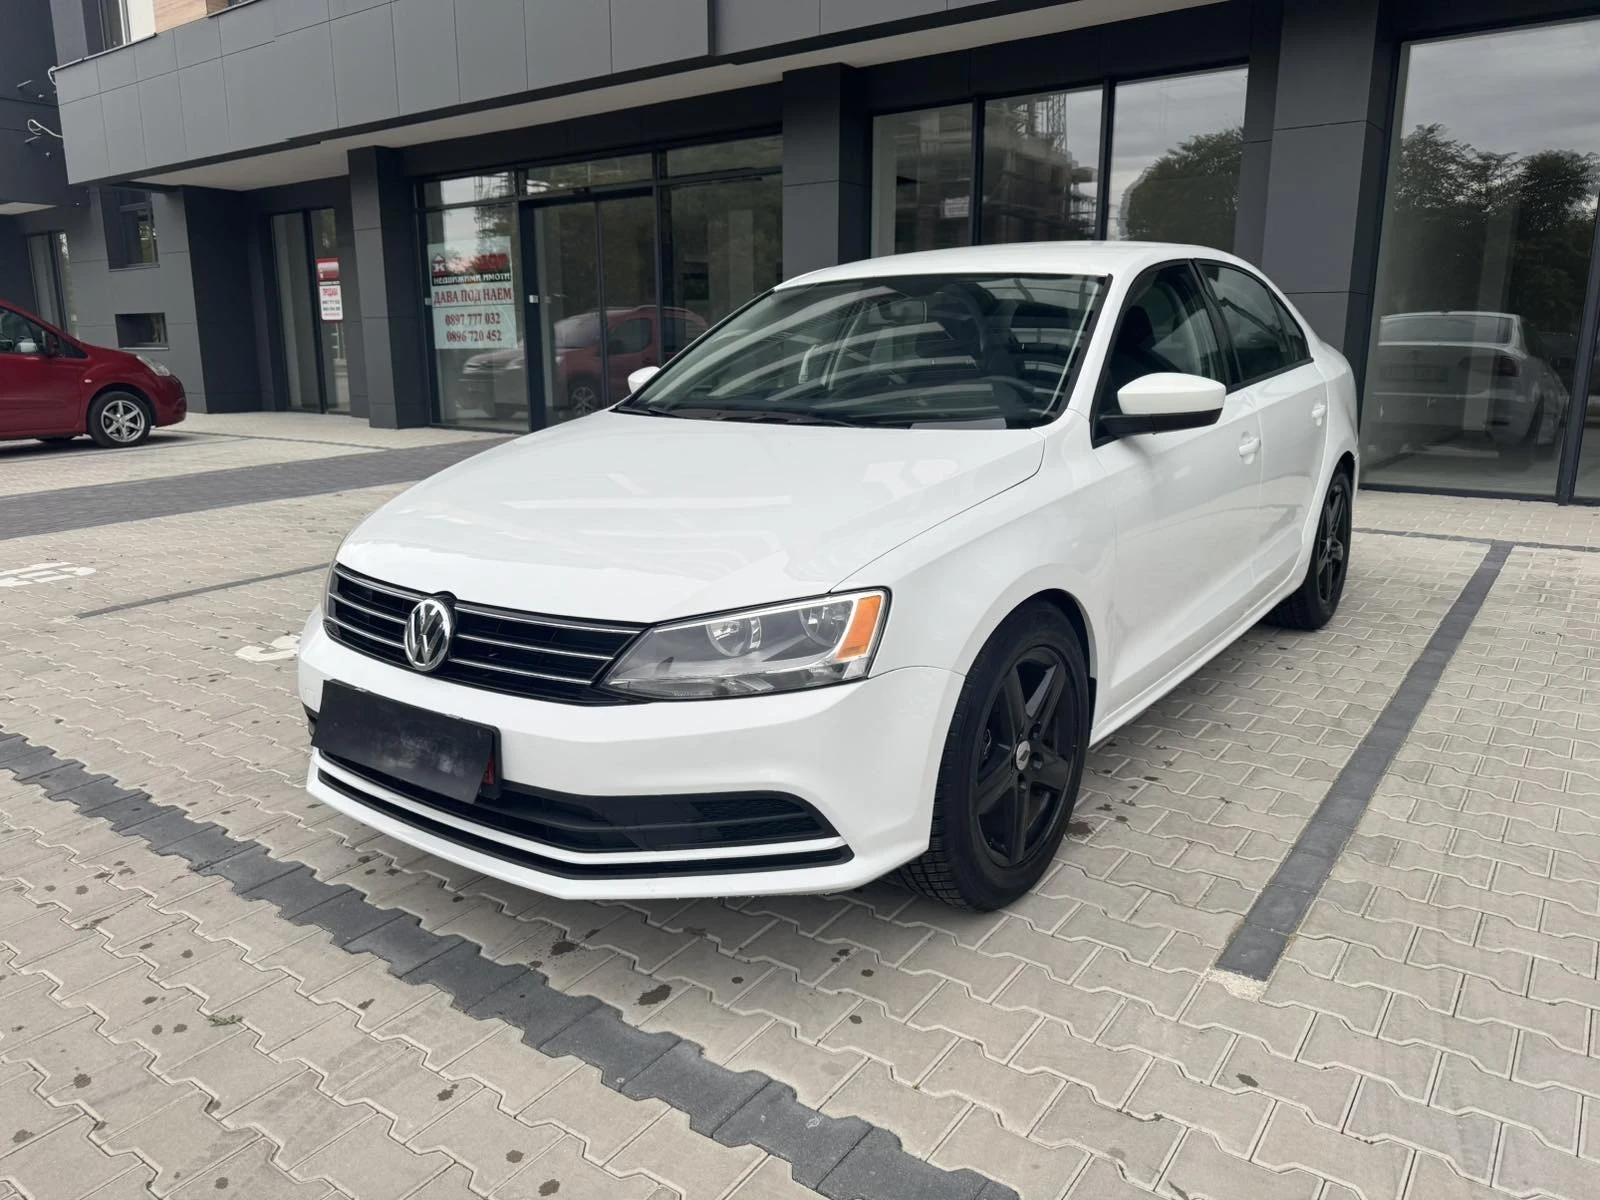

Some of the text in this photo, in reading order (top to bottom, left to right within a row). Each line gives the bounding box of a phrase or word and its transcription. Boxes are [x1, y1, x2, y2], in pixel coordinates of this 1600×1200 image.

[482, 272, 511, 281] ИМОТИ
[434, 287, 512, 305] ДАВА ПОД НАЕМ
[445, 312, 501, 326] 0897 777 032
[468, 330, 484, 341] 720
[486, 329, 502, 341] 452
